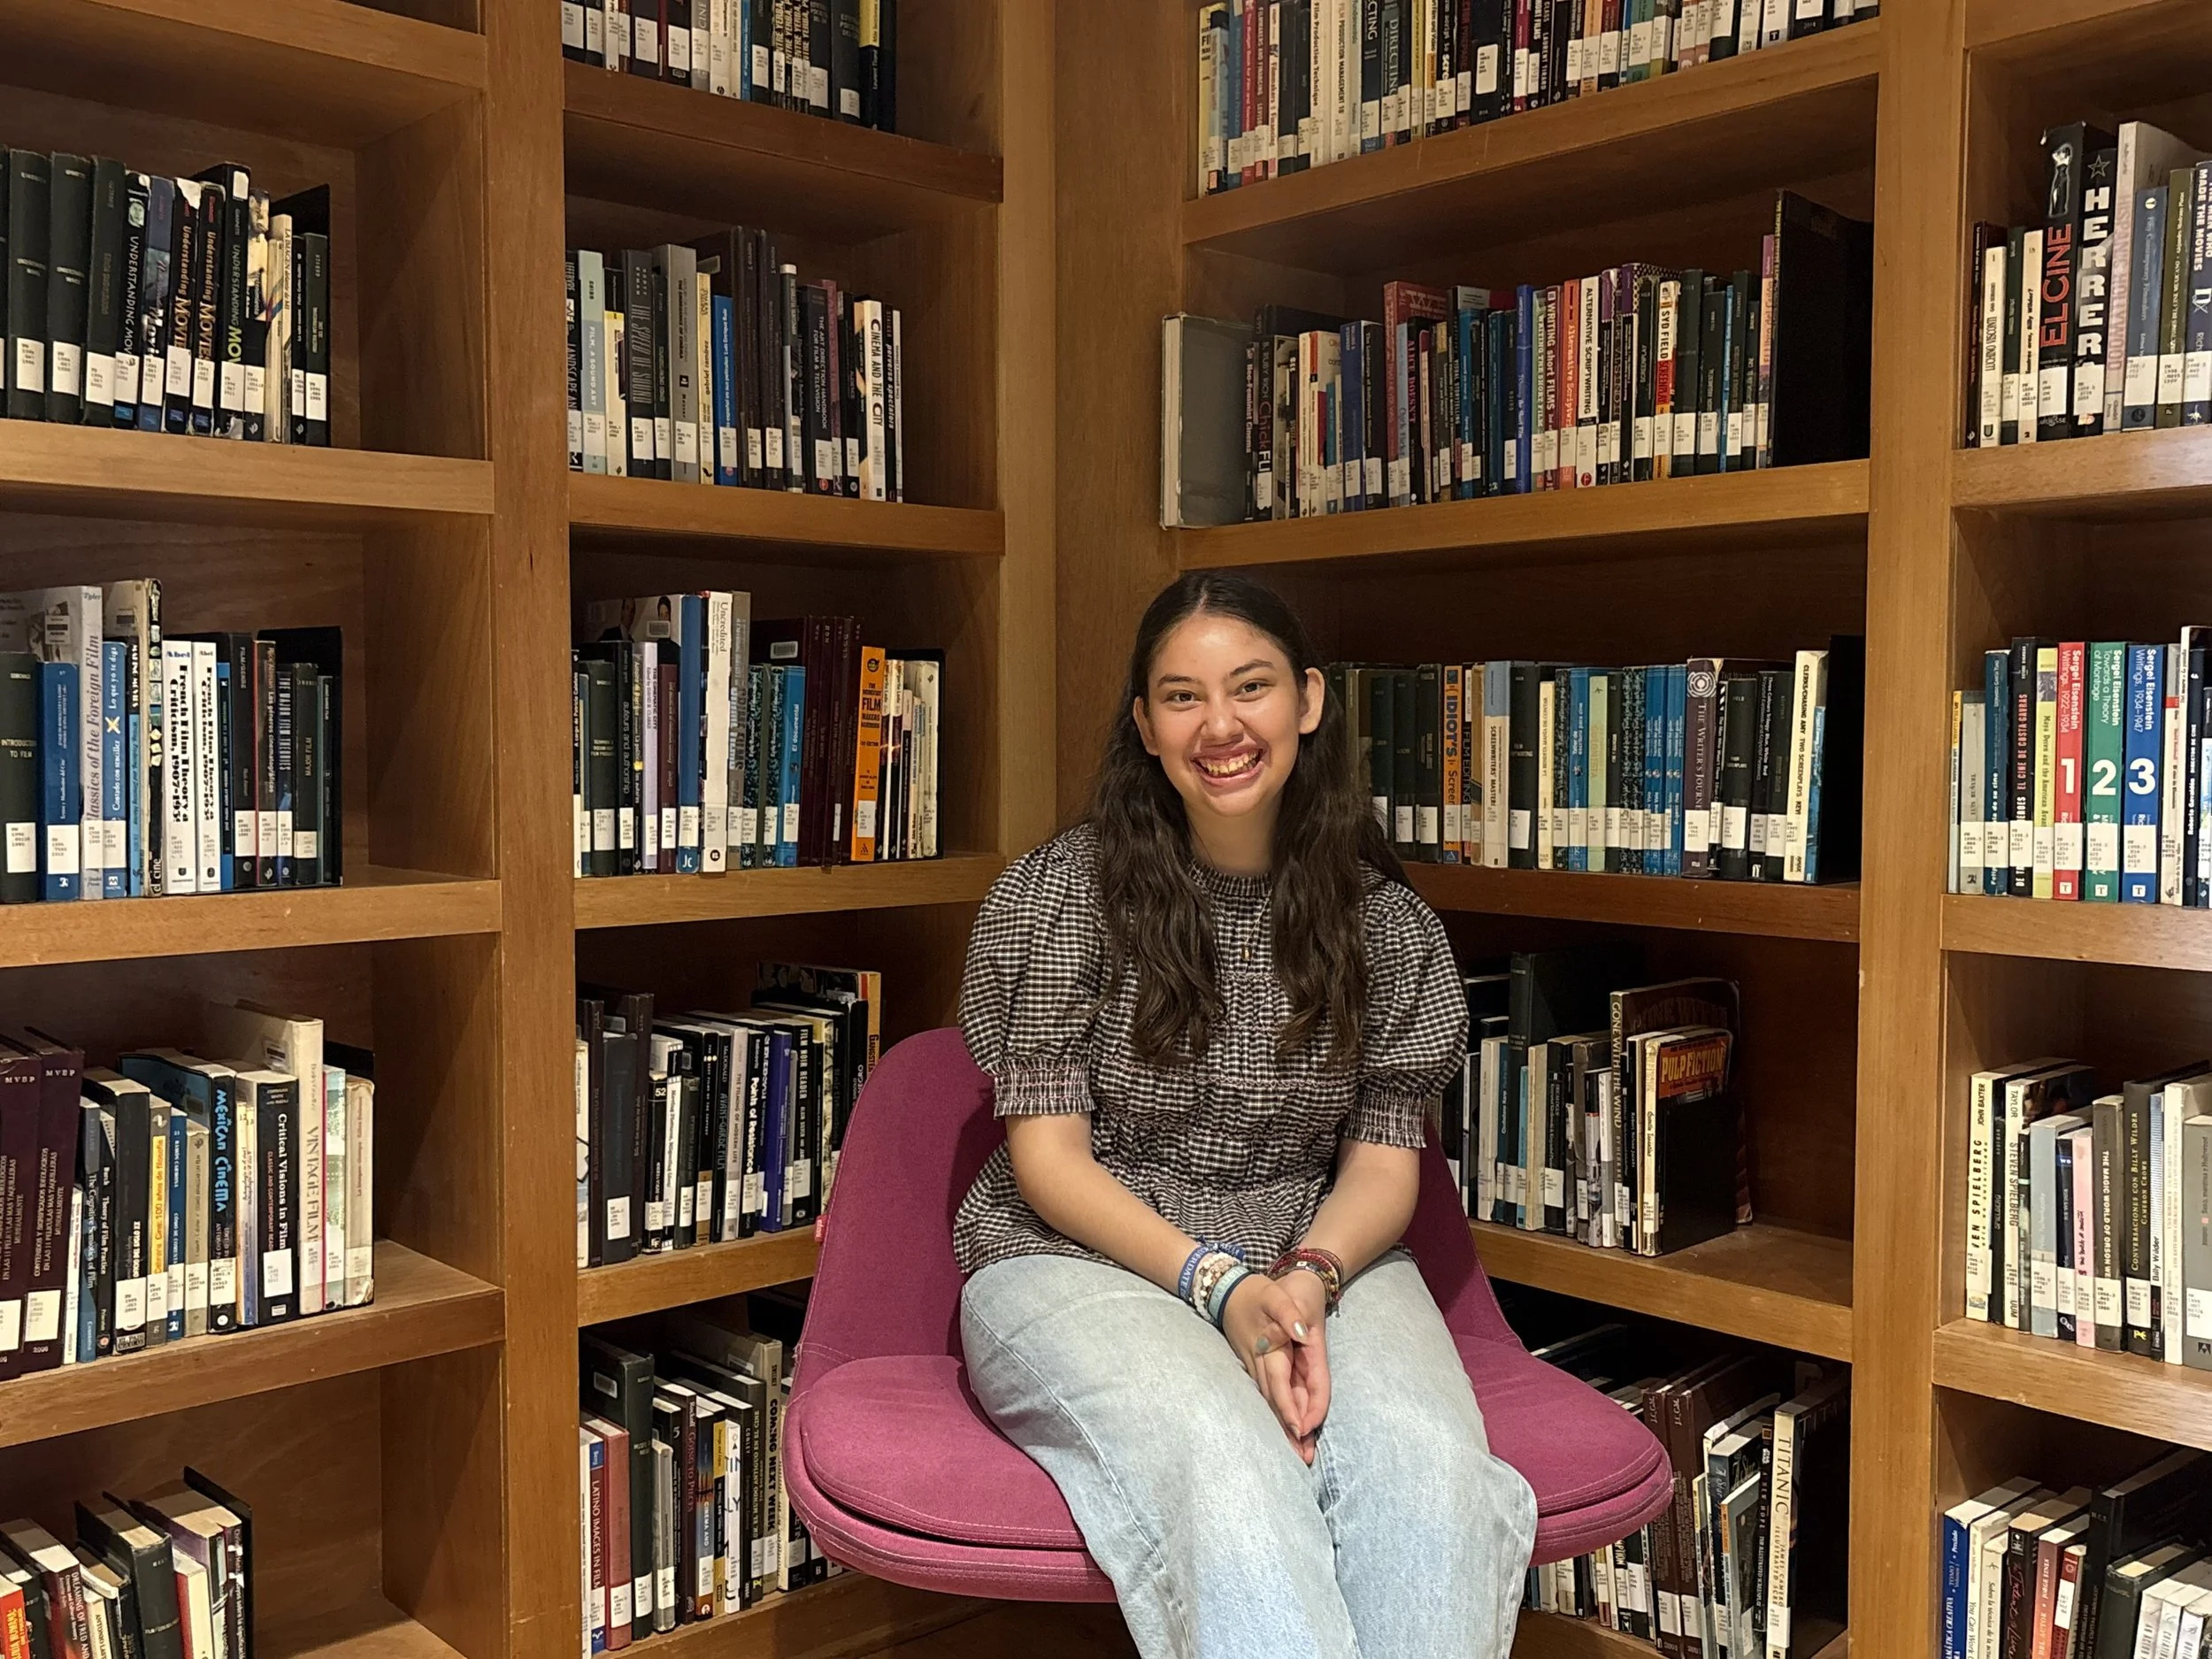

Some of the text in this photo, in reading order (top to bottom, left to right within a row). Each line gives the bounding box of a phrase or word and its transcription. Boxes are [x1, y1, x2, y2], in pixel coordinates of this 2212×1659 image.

[2198, 169, 2208, 202] MADE
[179, 226, 191, 295] Understanding
[203, 232, 216, 300] Understanding
[2194, 229, 2205, 272] MOVIES
[231, 245, 242, 326] UNDERSTANDING
[1546, 303, 1556, 411] WRITING short FILMS
[1566, 325, 1575, 380] Alternative
[1660, 311, 1671, 359] SYD FIELD
[633, 325, 652, 403] SPEED SOUND
[872, 319, 884, 426] CINEMA AND THE CITY
[1584, 346, 1593, 414] SCRIPTWRITING
[1259, 401, 1271, 449] Chick
[719, 602, 728, 653] Uncredited
[85, 635, 102, 752] the Foreign Film
[861, 697, 881, 711] FILM
[1801, 664, 1809, 718] CLERKS/CHASING
[2060, 649, 2070, 733] Writings, 1922-1934
[2070, 681, 2080, 730] Eisenstein
[2091, 660, 2101, 702] Montage
[2100, 649, 2113, 724] Towards Theory
[2111, 649, 2123, 726] Sergei Eisenstein
[2133, 649, 2146, 733] Writings, 1934-1947
[2144, 649, 2156, 731] Sergei Eisenstein
[169, 679, 180, 752] Criticism,
[180, 664, 191, 810] French Film Theory
[1447, 695, 1458, 758] IDIOT'S
[1696, 703, 1708, 772] THE WRITER'S
[2041, 715, 2050, 733] Maya
[622, 752, 631, 795] authorship
[2017, 749, 2027, 780] CINE DE
[2061, 758, 2076, 794] 1
[2092, 759, 2117, 795] 2
[2128, 758, 2156, 795] 3
[152, 858, 162, 880] cine
[798, 1028, 809, 1100] FILM NOIR READER
[1612, 1002, 1623, 1128] GONE WITH THE WIND
[1661, 1044, 1725, 1083] PULP FICTION
[655, 1087, 666, 1096] 52
[746, 1077, 759, 1173] Points Resistance
[89, 1174, 98, 1187] The
[278, 1113, 288, 1249] Critical Visions in Film
[306, 1126, 319, 1194] VINTAGE
[1971, 1140, 1982, 1215] SPIELBERG
[2009, 1142, 2019, 1227] STEVEN SPIELBERG
[2131, 1148, 2139, 1172] BILLY
[88, 1188, 98, 1221] Cognitive
[101, 1195, 111, 1219] Theory
[155, 1204, 164, 1220] 100
[2131, 1196, 2139, 1271] CONVERSACIONES
[101, 1248, 110, 1275] Practice
[673, 1426, 680, 1439] 5
[592, 1479, 601, 1517] LATINO
[767, 1456, 778, 1531] NEXT WEEK
[1775, 1436, 1792, 1516] TITANIC
[593, 1517, 602, 1552] IMAGES
[815, 1564, 823, 1575] B
